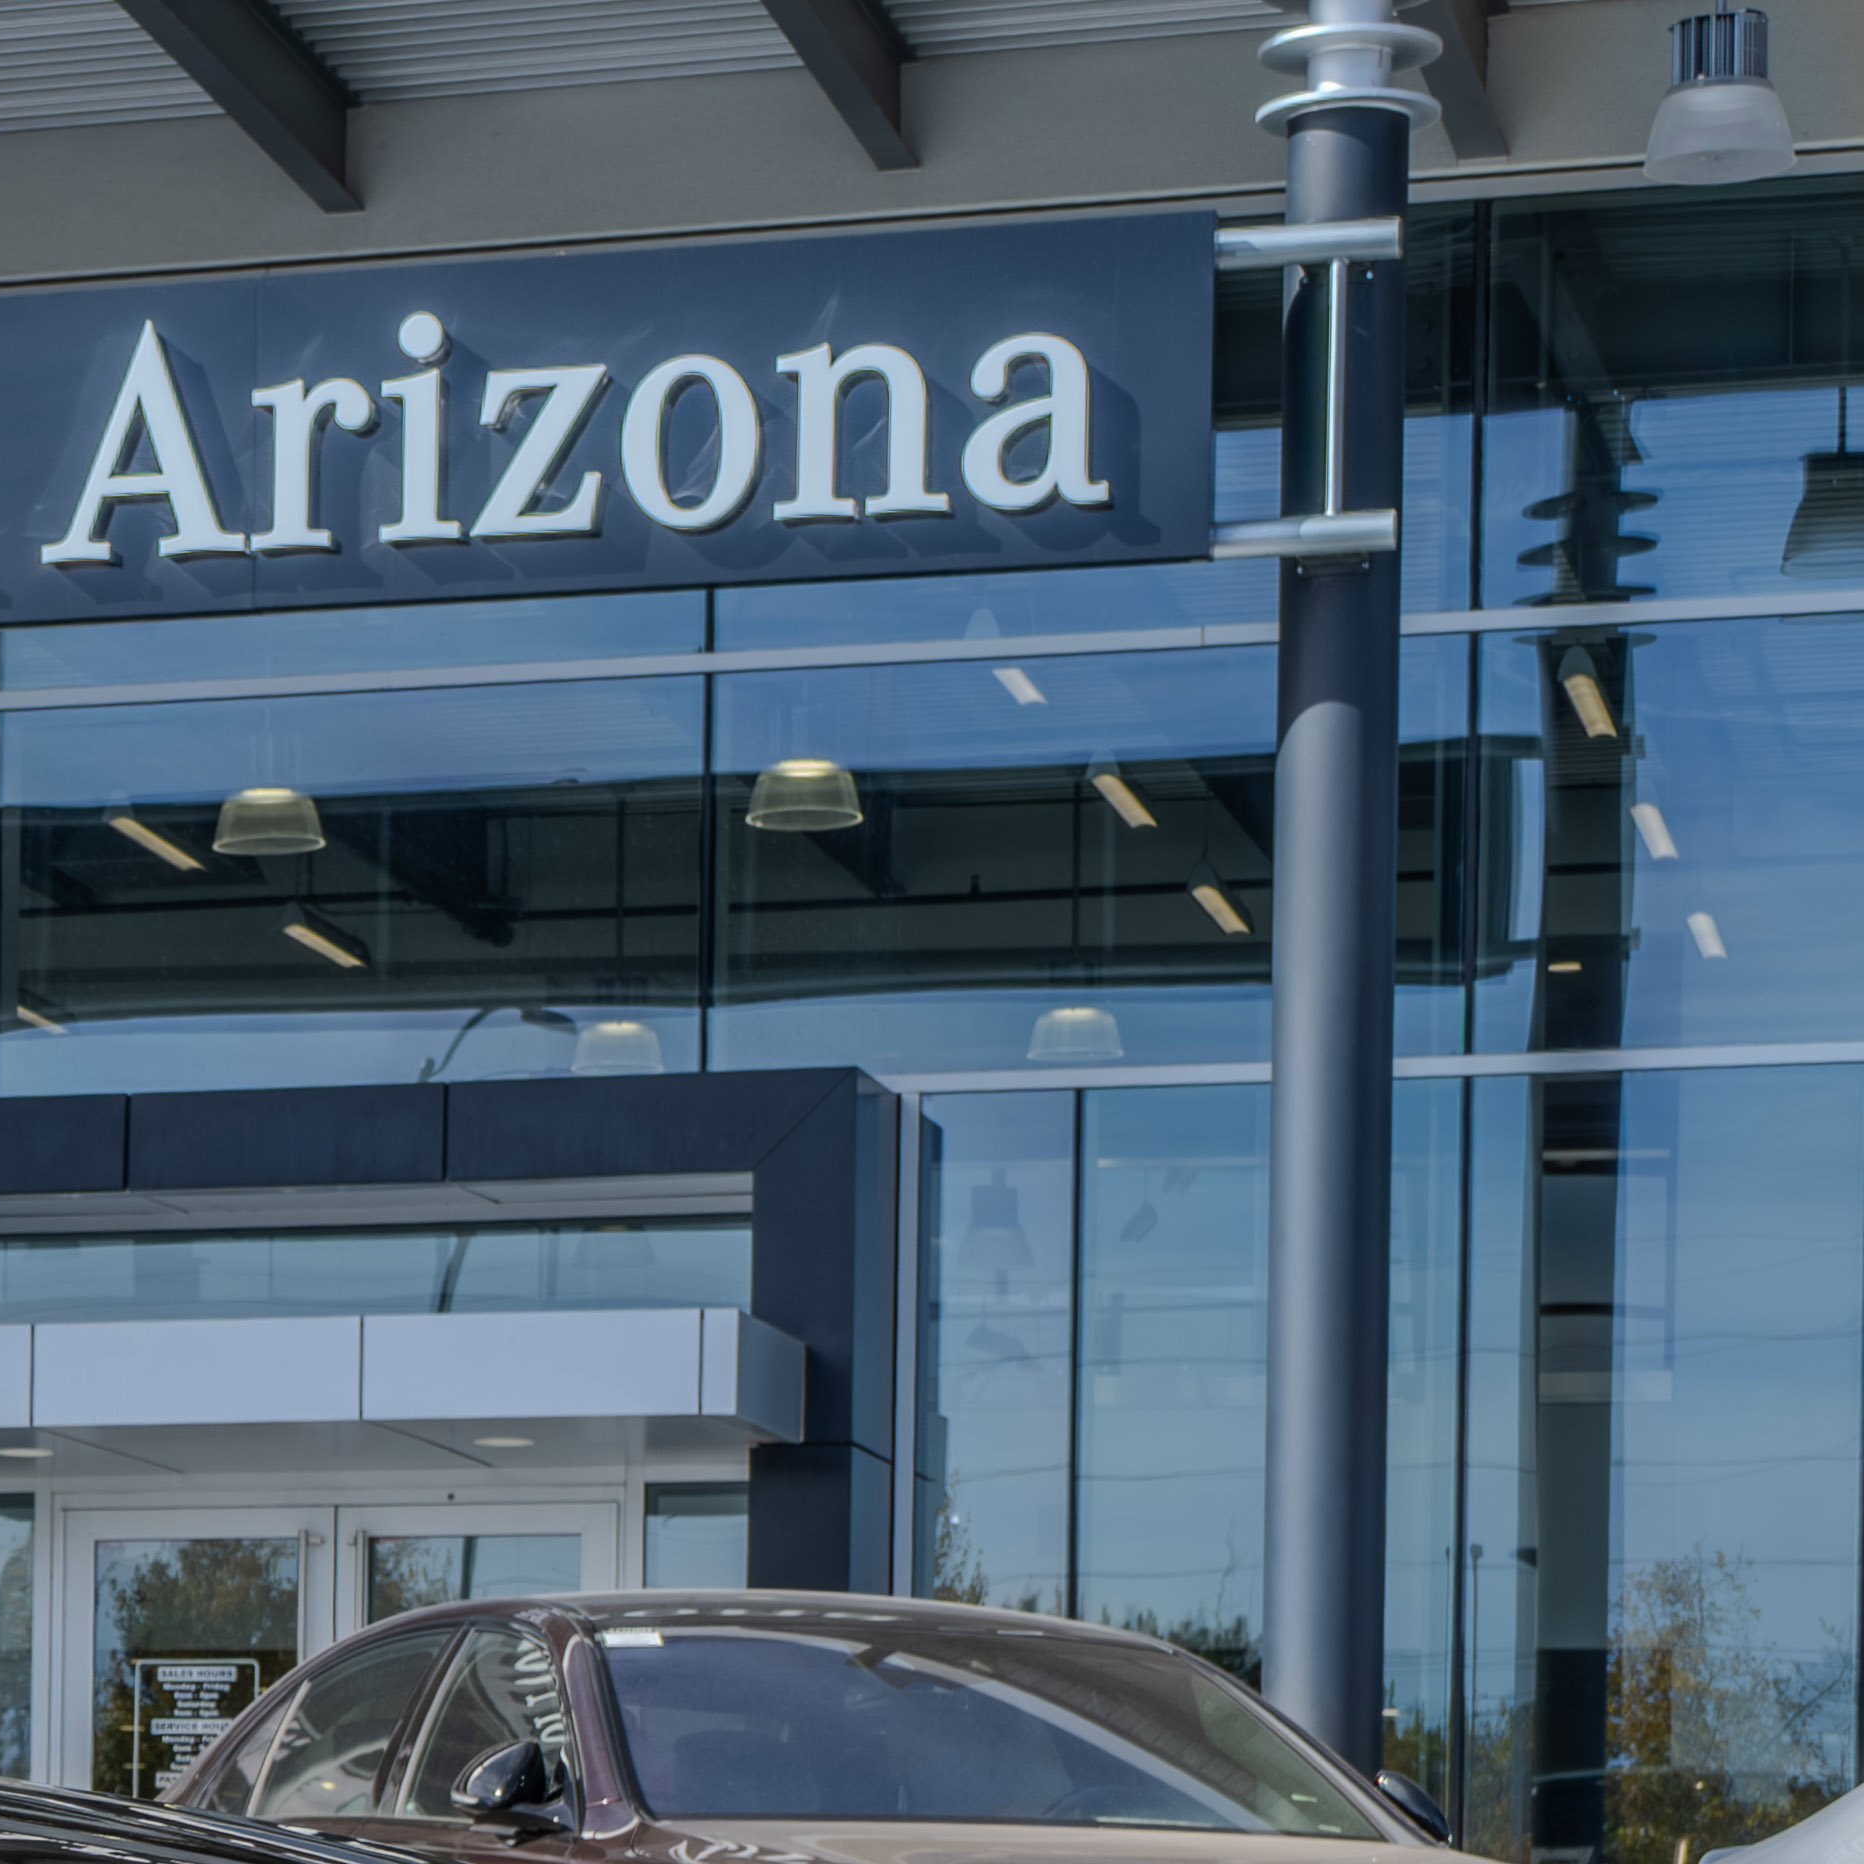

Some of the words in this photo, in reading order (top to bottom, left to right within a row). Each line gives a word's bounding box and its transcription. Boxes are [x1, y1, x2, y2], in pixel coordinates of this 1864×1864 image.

[39, 309, 1111, 566] Arizona
[161, 1669, 194, 1678] SALES
[197, 1669, 233, 1678] HOURS
[154, 1721, 198, 1731] SERVICE
